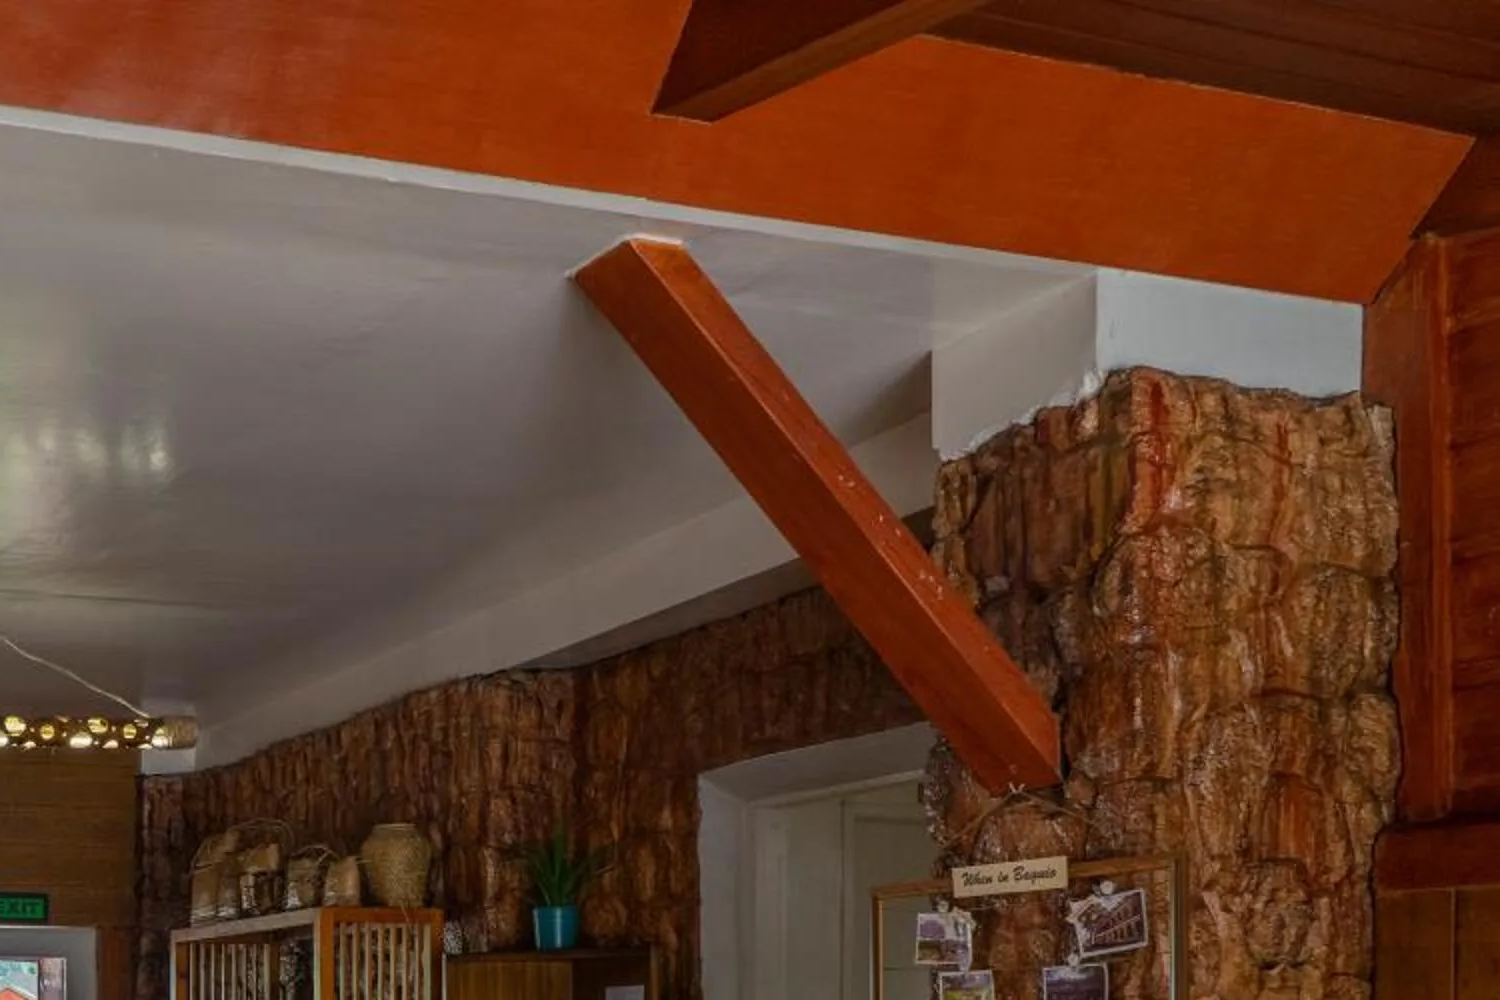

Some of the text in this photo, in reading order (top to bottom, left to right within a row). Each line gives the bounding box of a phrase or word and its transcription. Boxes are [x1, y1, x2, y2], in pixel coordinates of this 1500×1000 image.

[962, 864, 1057, 887] When in Baguio
